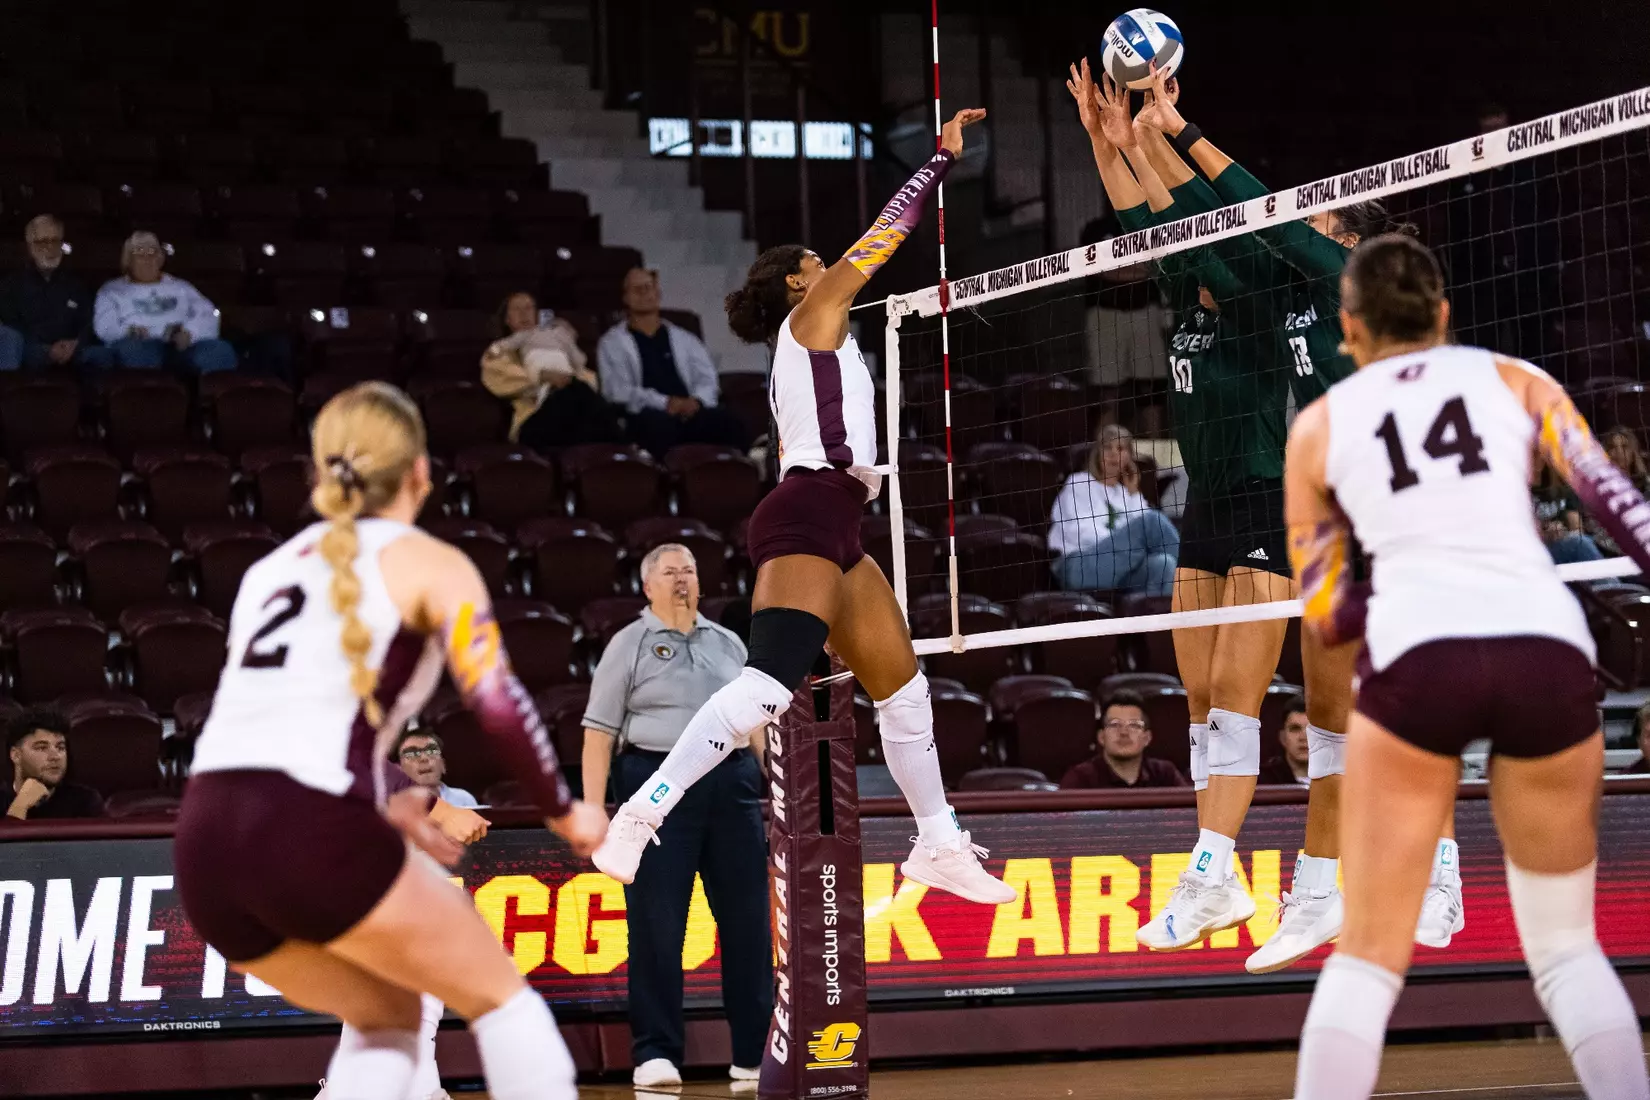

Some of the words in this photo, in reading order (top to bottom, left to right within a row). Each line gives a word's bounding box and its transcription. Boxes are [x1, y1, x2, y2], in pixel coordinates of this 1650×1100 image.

[1507, 119, 1555, 152] CENTRAL
[1559, 99, 1614, 138] MICHIGAN
[874, 167, 936, 231] CHIPPEWAS
[1296, 178, 1336, 210] CENTRAL
[1340, 167, 1387, 198] MICHIGAN
[1390, 147, 1450, 184] VOLLEYBALL
[1112, 231, 1150, 259] CENTRAL
[1150, 218, 1193, 249] MICHIGAN
[1194, 204, 1247, 237] VOLLEYBALL
[954, 277, 986, 301] CENTRAL
[988, 267, 1024, 293] MICHIGAN
[1025, 252, 1070, 282] VOLLEYBALL
[1169, 355, 1193, 394] 10
[1374, 396, 1491, 493] 14
[240, 585, 307, 668] 2
[768, 722, 786, 822] MIC
[819, 864, 840, 925] sports
[771, 852, 790, 1065] CENTRAL
[822, 929, 842, 1006] imports
[945, 986, 1015, 997] DAKTRONICS
[143, 1021, 221, 1032] DAKTRONICS
[810, 1086, 827, 1095] (800)
[827, 1085, 857, 1094] 556-3198
